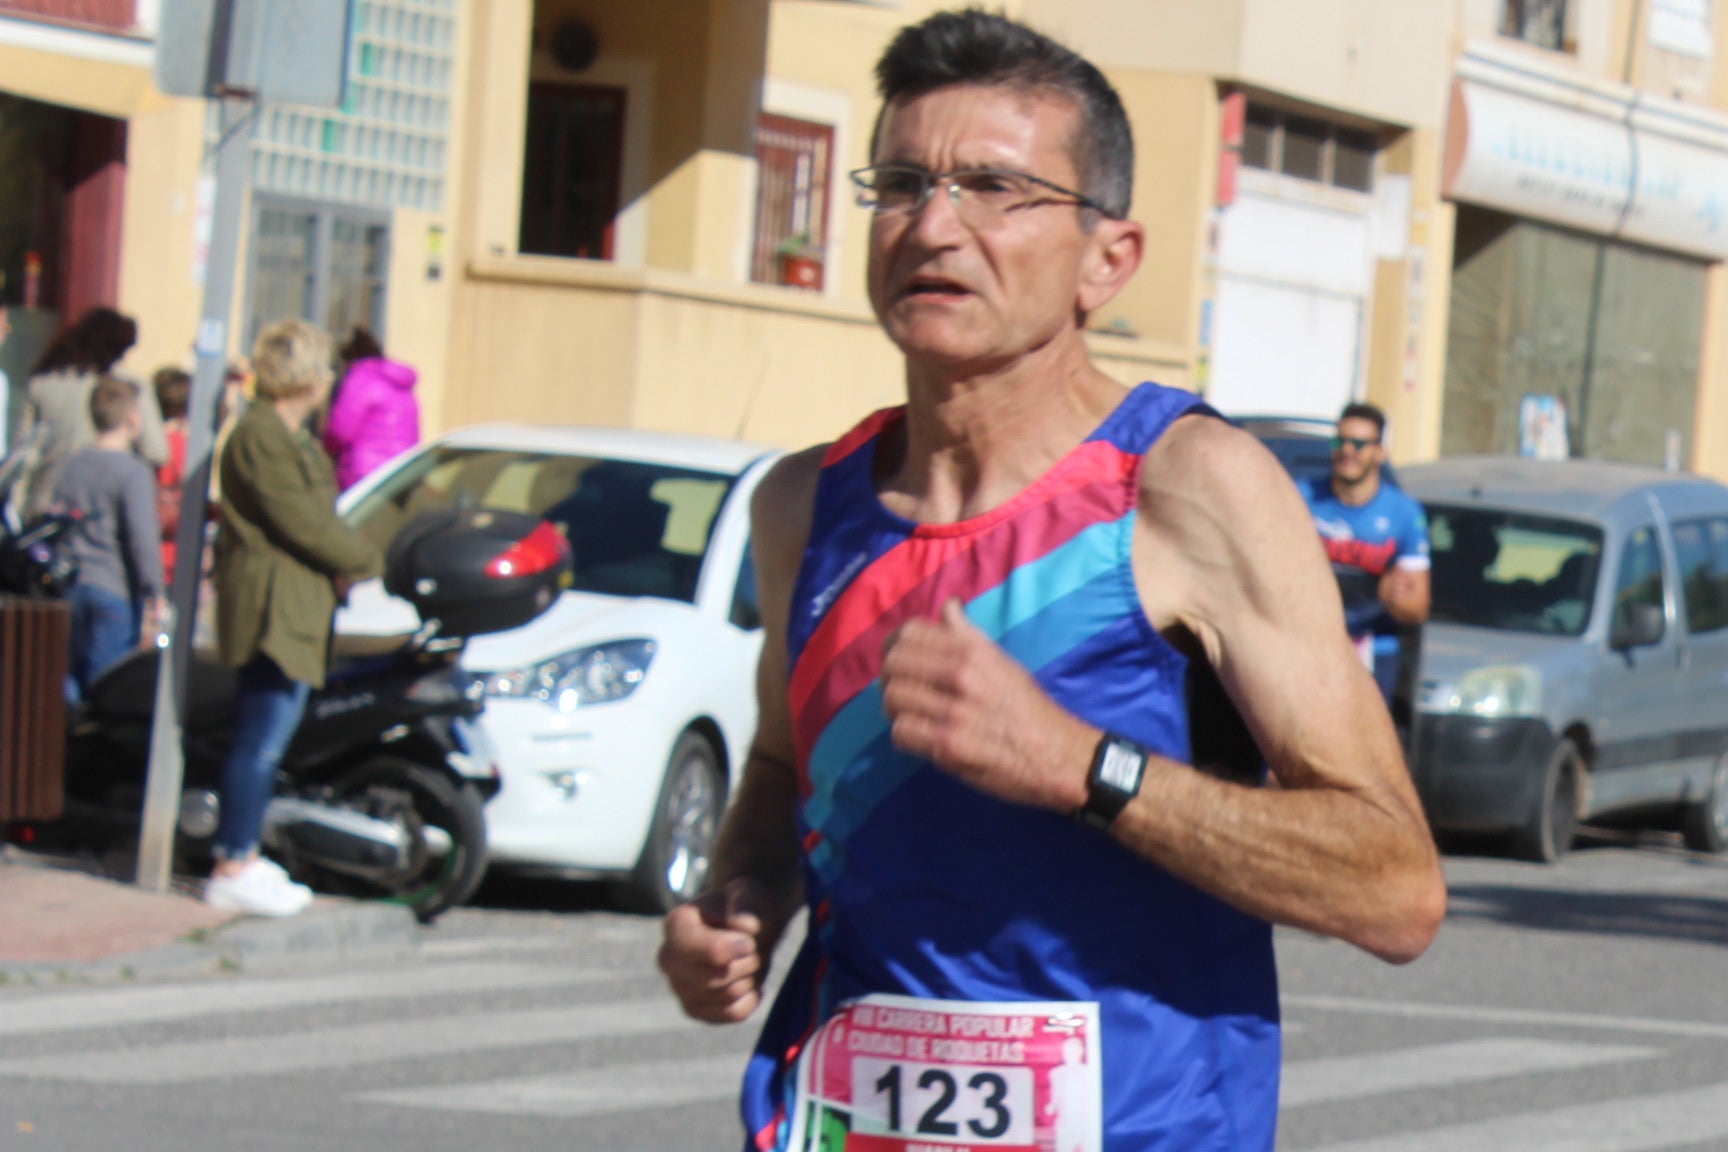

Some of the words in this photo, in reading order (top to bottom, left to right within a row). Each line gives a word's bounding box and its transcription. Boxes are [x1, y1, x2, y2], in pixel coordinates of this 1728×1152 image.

[876, 1007, 946, 1034] CARRERA
[950, 1014, 1034, 1038] POPULAR
[876, 1065, 1011, 1139] 123
